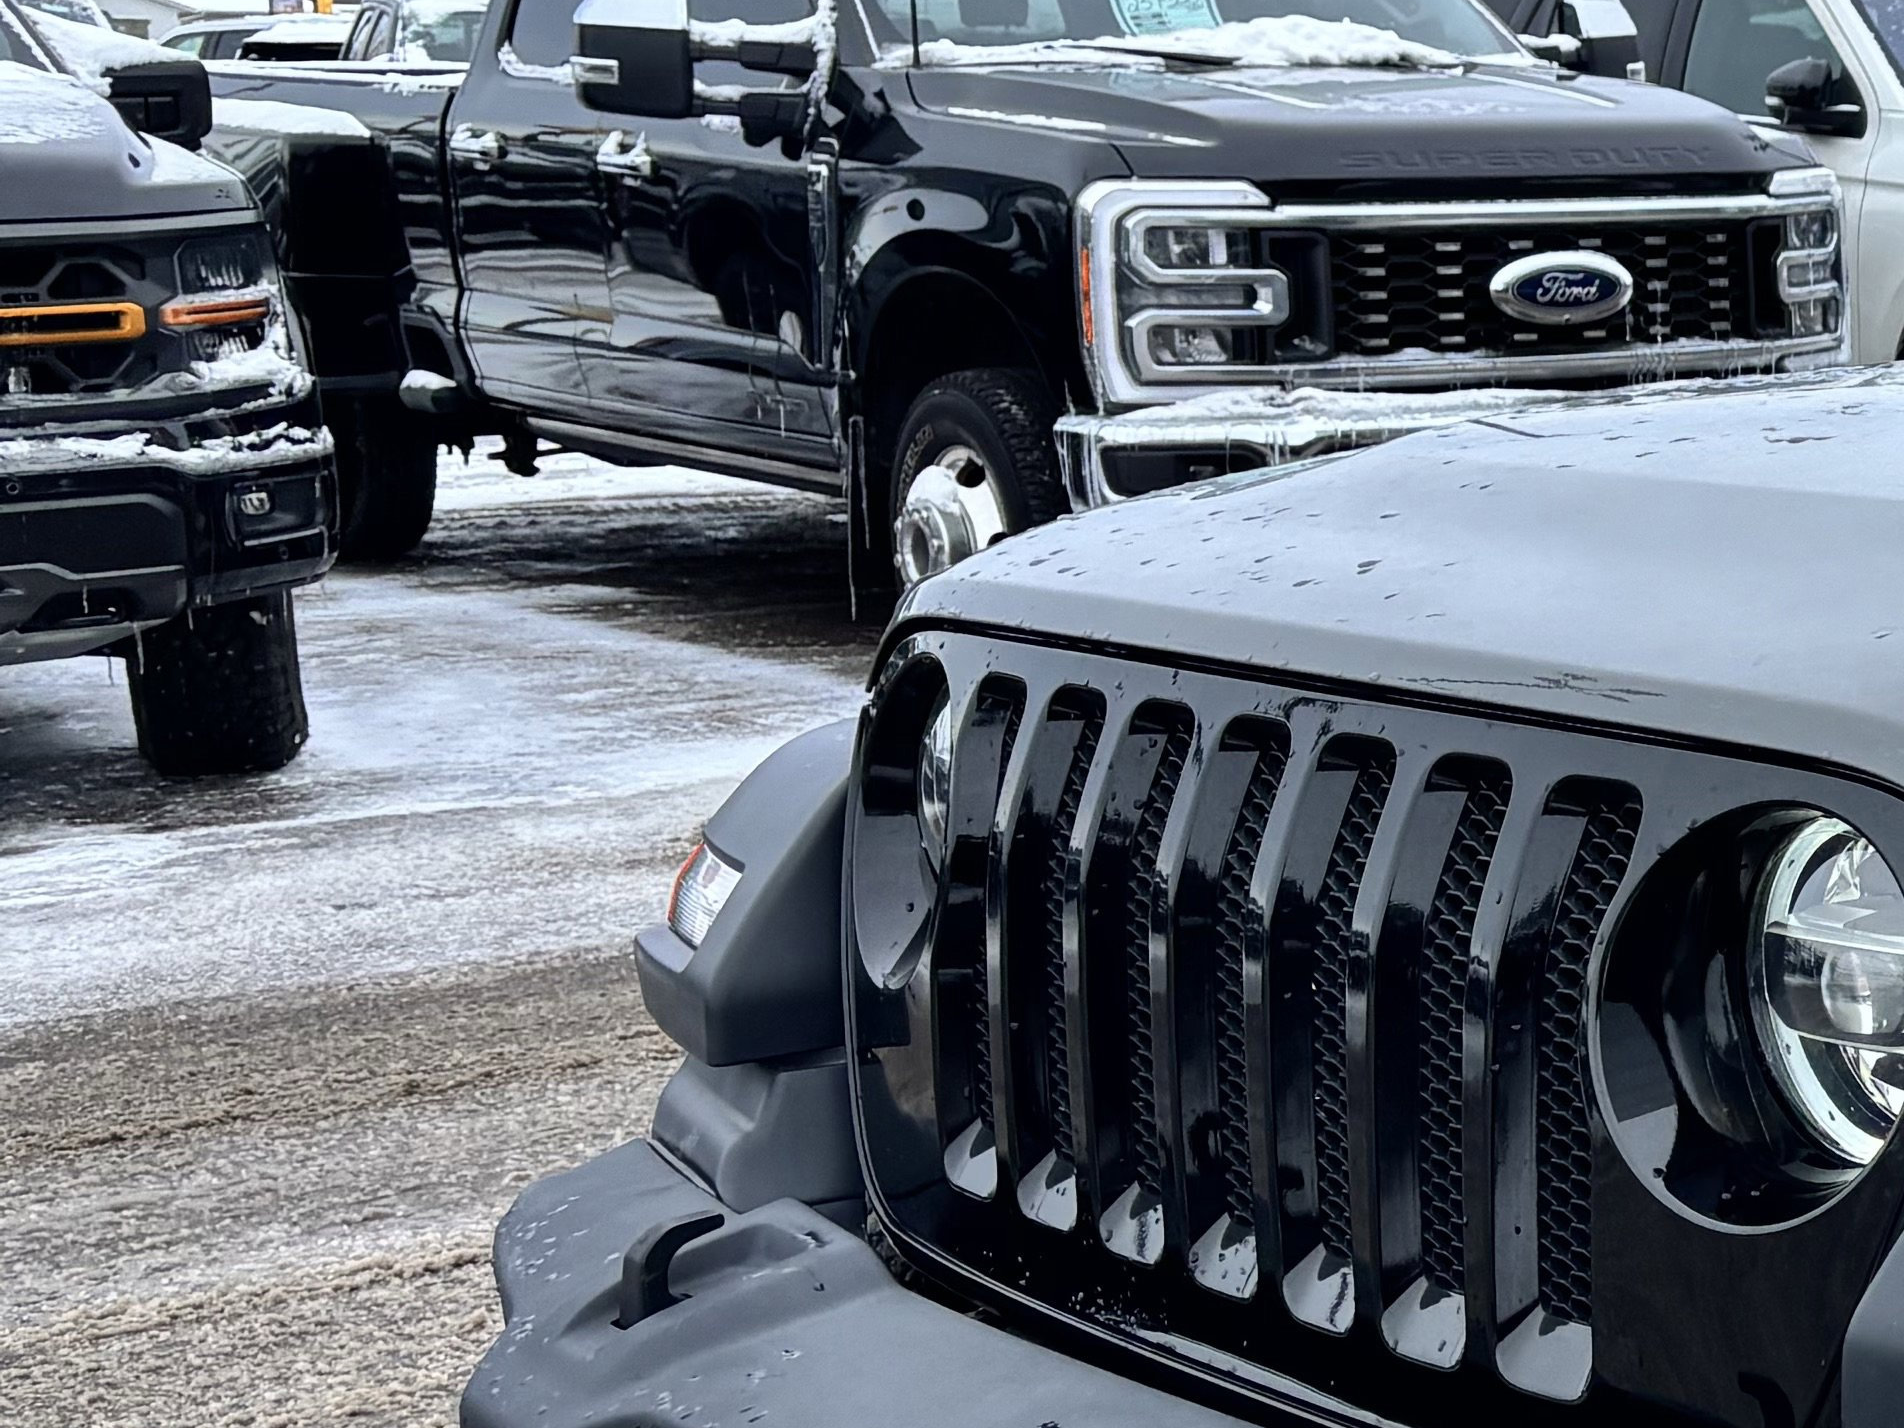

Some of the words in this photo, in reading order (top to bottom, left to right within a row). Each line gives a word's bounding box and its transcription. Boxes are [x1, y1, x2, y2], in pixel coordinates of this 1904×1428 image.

[1338, 149, 1557, 171] SUPER
[1568, 145, 1712, 169] DUTY
[1536, 271, 1600, 303] Ford
